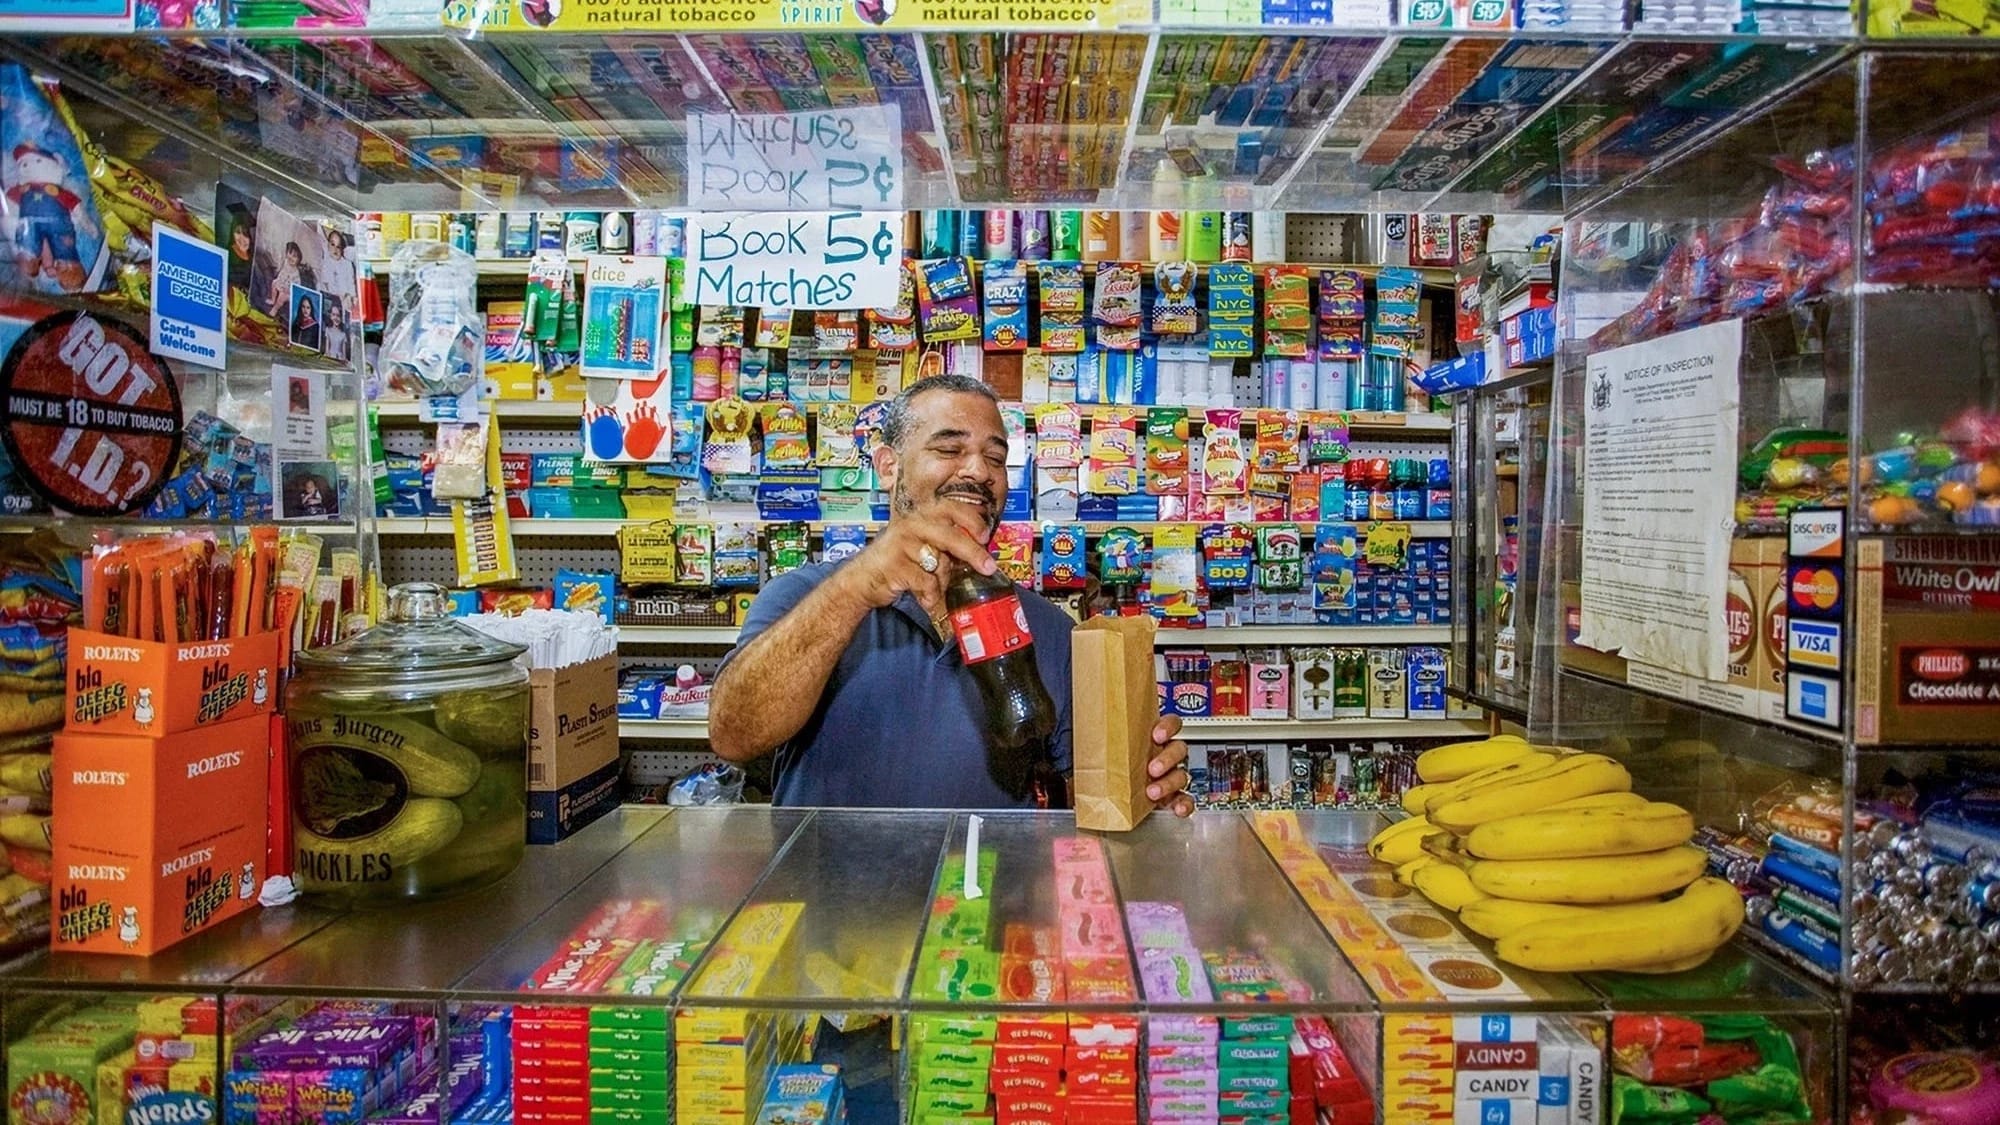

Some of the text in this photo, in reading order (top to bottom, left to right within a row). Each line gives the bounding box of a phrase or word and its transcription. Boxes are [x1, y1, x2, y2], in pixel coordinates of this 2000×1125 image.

[587, 8, 756, 23] natural tobacco
[781, 6, 842, 24] SPIRIT
[922, 6, 1096, 22] natural tobacco
[1387, 220, 1405, 237] Gel
[701, 219, 809, 262] Book
[157, 262, 220, 292] AMERICAN
[591, 265, 626, 281] dice
[1216, 272, 1249, 283] NYC
[695, 264, 856, 306] Matches
[986, 286, 1025, 299] CRAZY
[170, 283, 222, 308] EXPRESS
[1216, 299, 1249, 309] NYC
[159, 318, 196, 339] Cards
[159, 332, 216, 358] Welcome
[1214, 340, 1248, 350] NYC
[58, 311, 157, 406] GOT
[1624, 354, 1714, 381] NOTICE OF INSPECTION
[1135, 356, 1144, 393] TAMPAX
[9, 395, 174, 433] MUST BE 18 TO BUY TOBACCO
[1793, 523, 1838, 534] DISCOVER
[1212, 537, 1245, 548] 809
[1208, 566, 1247, 578] 809
[1896, 566, 2000, 592] White Owl
[178, 643, 231, 661] ROLETS
[1798, 634, 1831, 653] VISA
[84, 646, 142, 662] ROLETS
[1918, 653, 1963, 673] PHILLIES
[1908, 682, 1983, 698] Chocolate
[74, 696, 127, 723] CHEESE
[197, 685, 248, 724] CHEESE
[187, 751, 242, 779] ROLETS
[73, 771, 127, 786] ROLETS
[161, 848, 214, 878] ROLETS
[299, 848, 392, 883] PICKLES
[68, 865, 127, 881] ROLETS
[1010, 1029, 1053, 1040] RED HOTS
[1007, 1054, 1050, 1066] RED HOTS
[1466, 1049, 1526, 1064] CANDY
[1469, 1079, 1530, 1093] CANDY
[1578, 1062, 1592, 1123] CANDY
